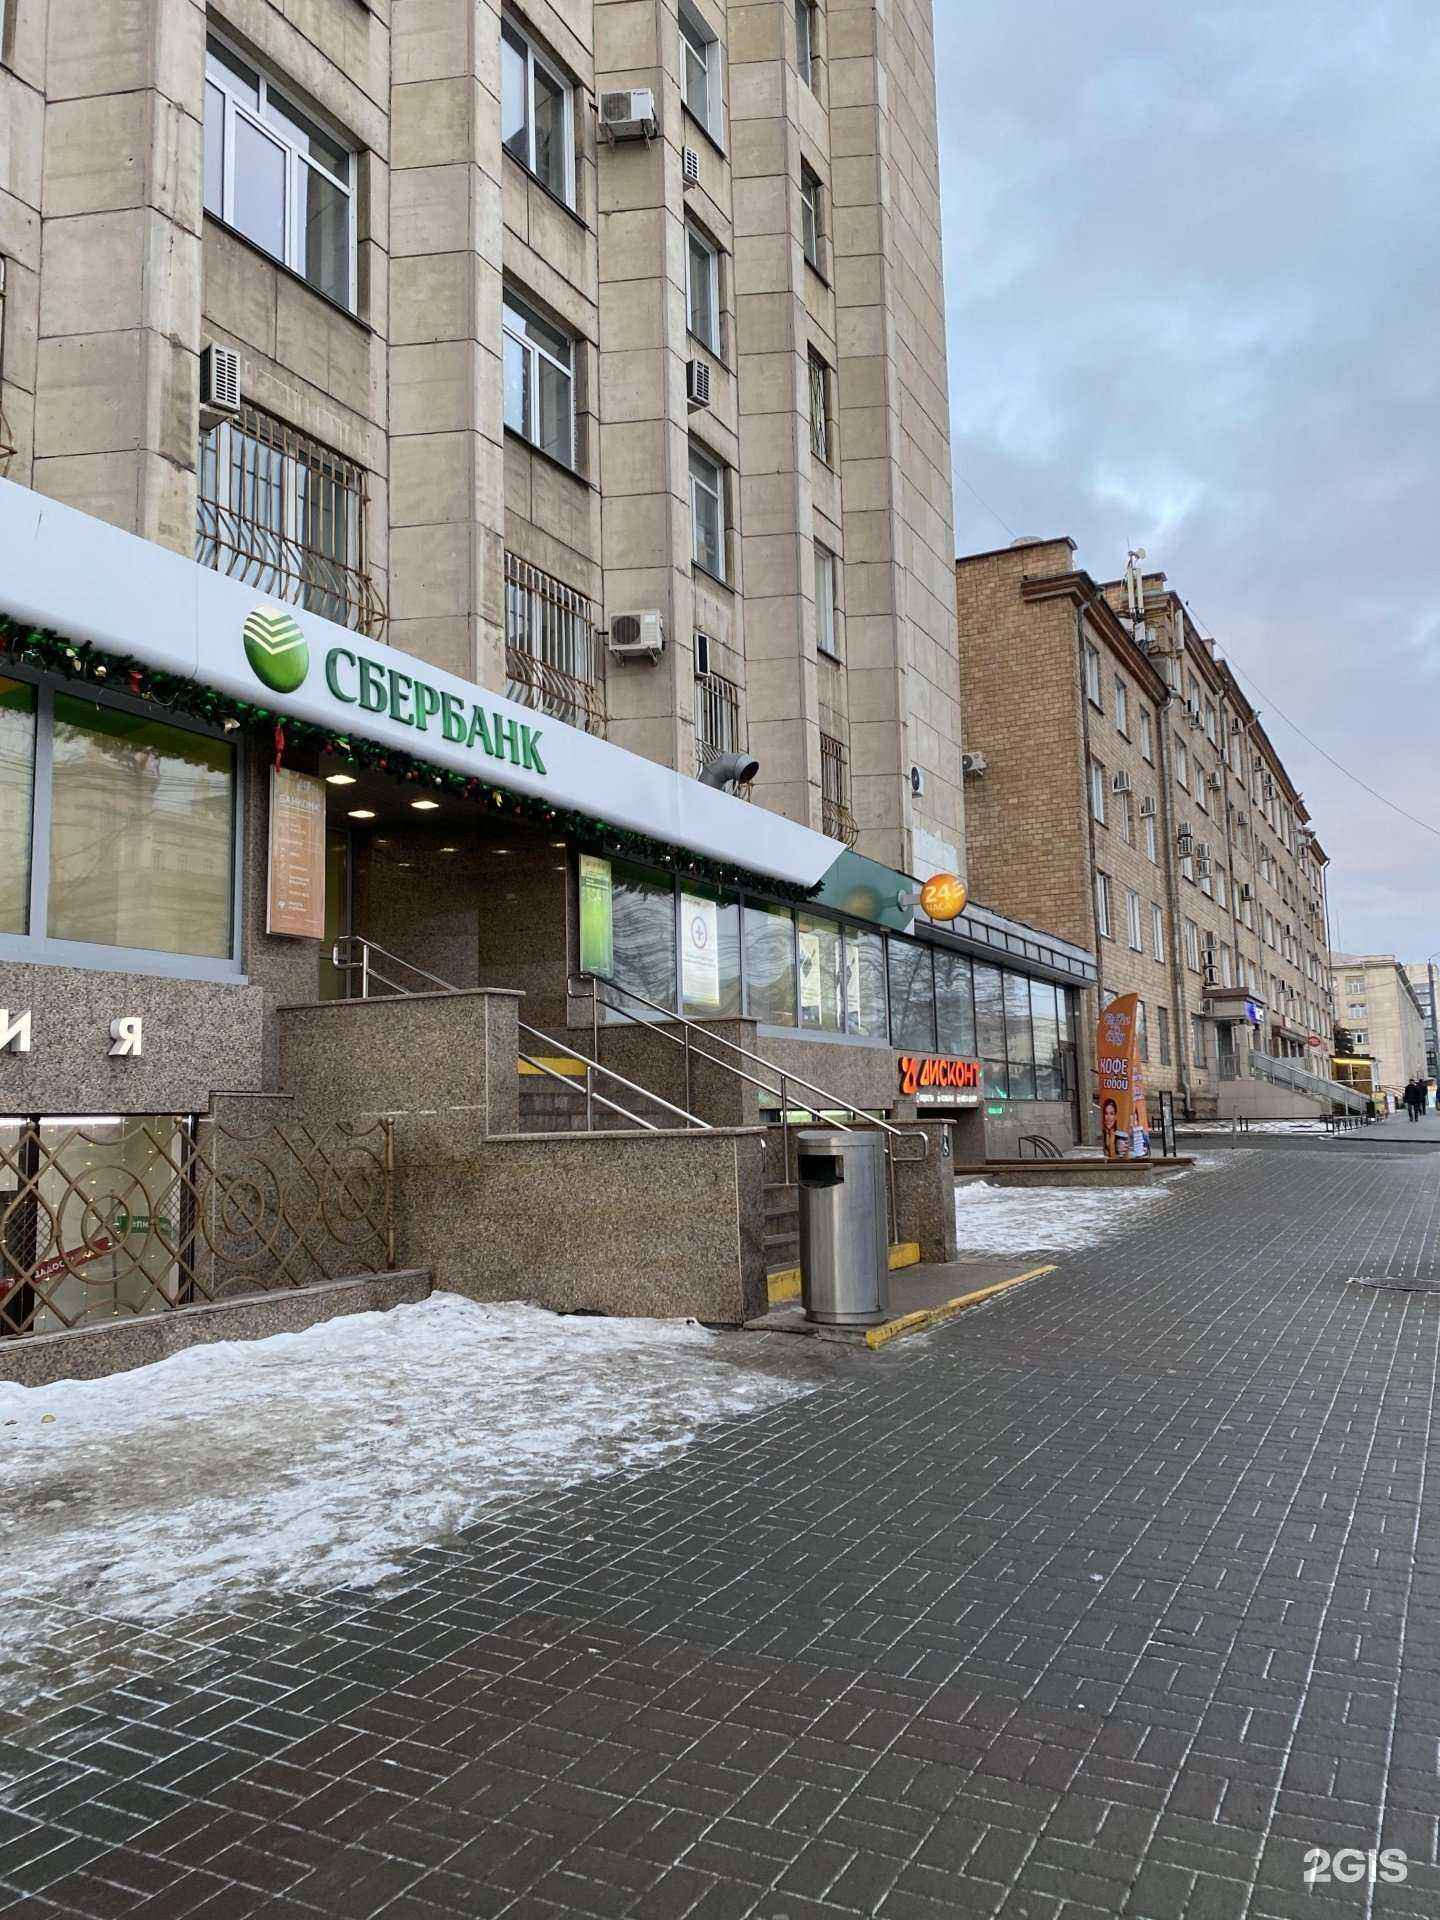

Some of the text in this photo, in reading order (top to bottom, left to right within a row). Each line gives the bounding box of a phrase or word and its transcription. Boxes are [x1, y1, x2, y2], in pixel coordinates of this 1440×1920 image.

[325, 647, 547, 776] СБЕРБАНК
[925, 883, 952, 903] 24
[921, 1057, 980, 1087] ДИСКОНТ
[1100, 1057, 1129, 1075] КОФЕ
